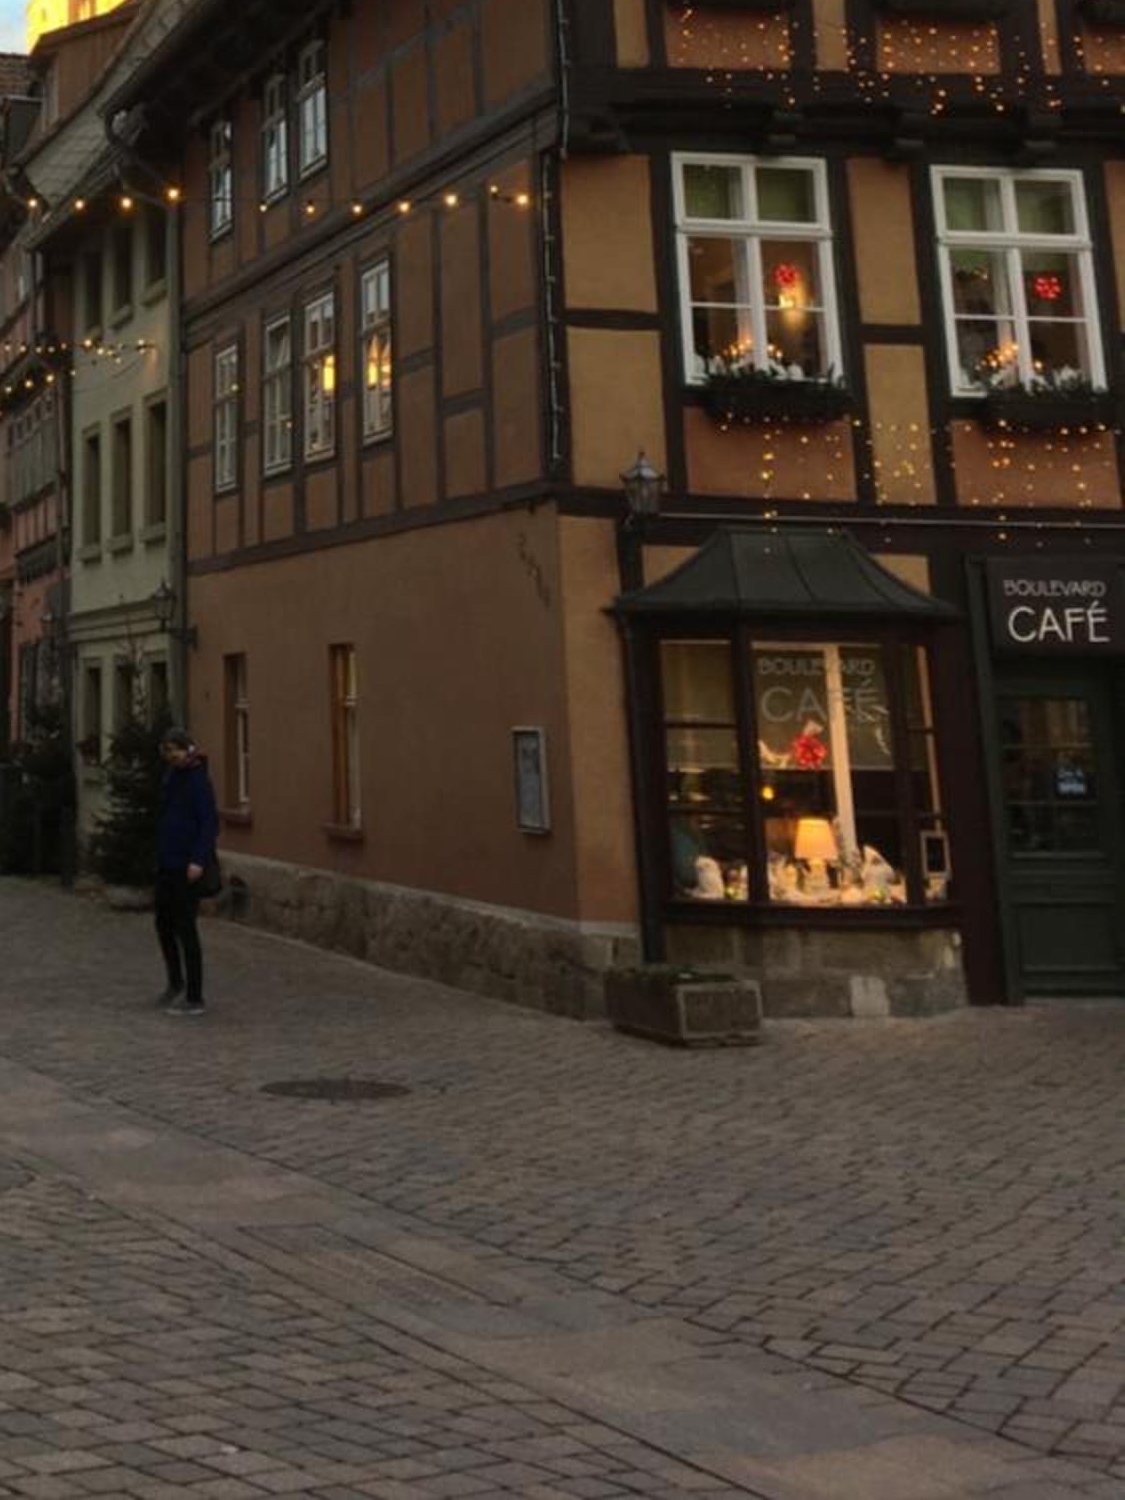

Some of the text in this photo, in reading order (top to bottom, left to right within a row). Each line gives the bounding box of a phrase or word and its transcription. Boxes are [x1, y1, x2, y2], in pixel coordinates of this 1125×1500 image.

[1003, 579, 1107, 597] BOULEVARD
[1008, 601, 1110, 642] CAFÉ
[757, 657, 875, 676] BOULEARD
